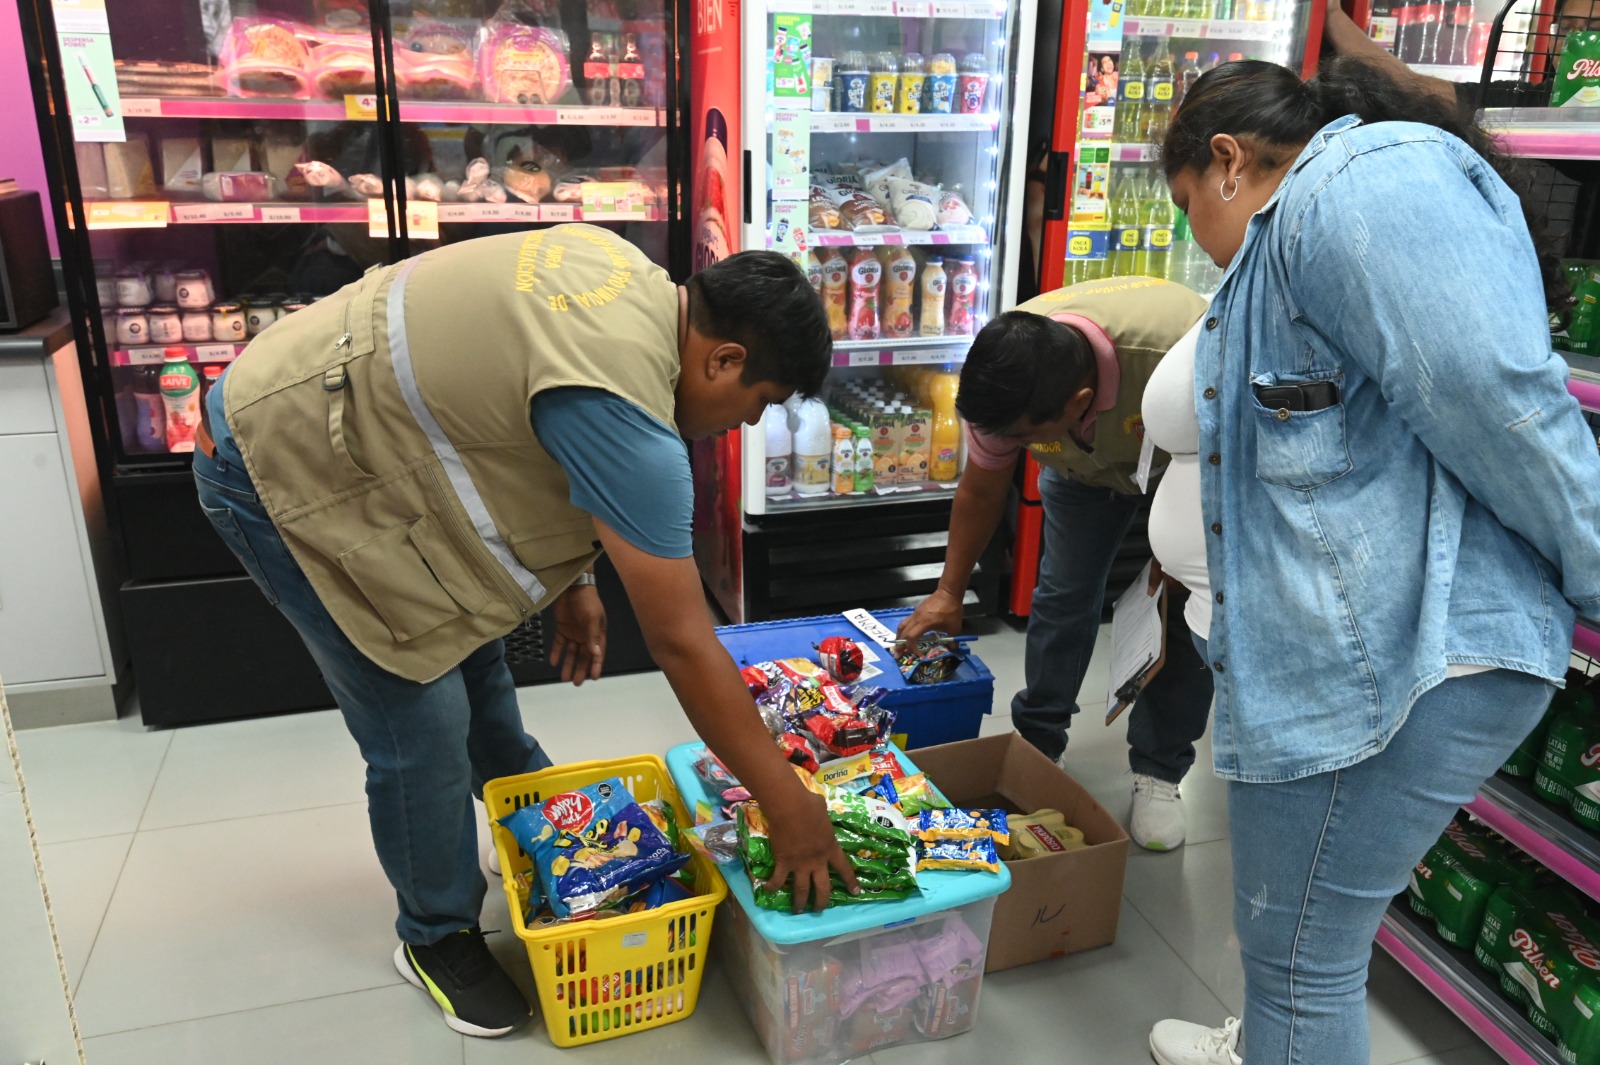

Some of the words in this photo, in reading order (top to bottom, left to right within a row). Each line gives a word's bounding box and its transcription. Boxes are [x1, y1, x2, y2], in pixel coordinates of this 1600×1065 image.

[697, 0, 723, 34] BIEN
[1566, 58, 1600, 80] Pils
[544, 244, 565, 269] PIURA
[547, 294, 569, 312] DE
[161, 377, 190, 388] LAIVE
[874, 420, 895, 428] GLORIA
[905, 418, 926, 426] GLORIA
[1547, 738, 1567, 752] LATAS
[823, 768, 848, 782] Dorina
[1573, 796, 1600, 821] ALCOHÓL
[1033, 825, 1061, 850] CUSQUEÑA
[1509, 928, 1560, 989] Pilsen
